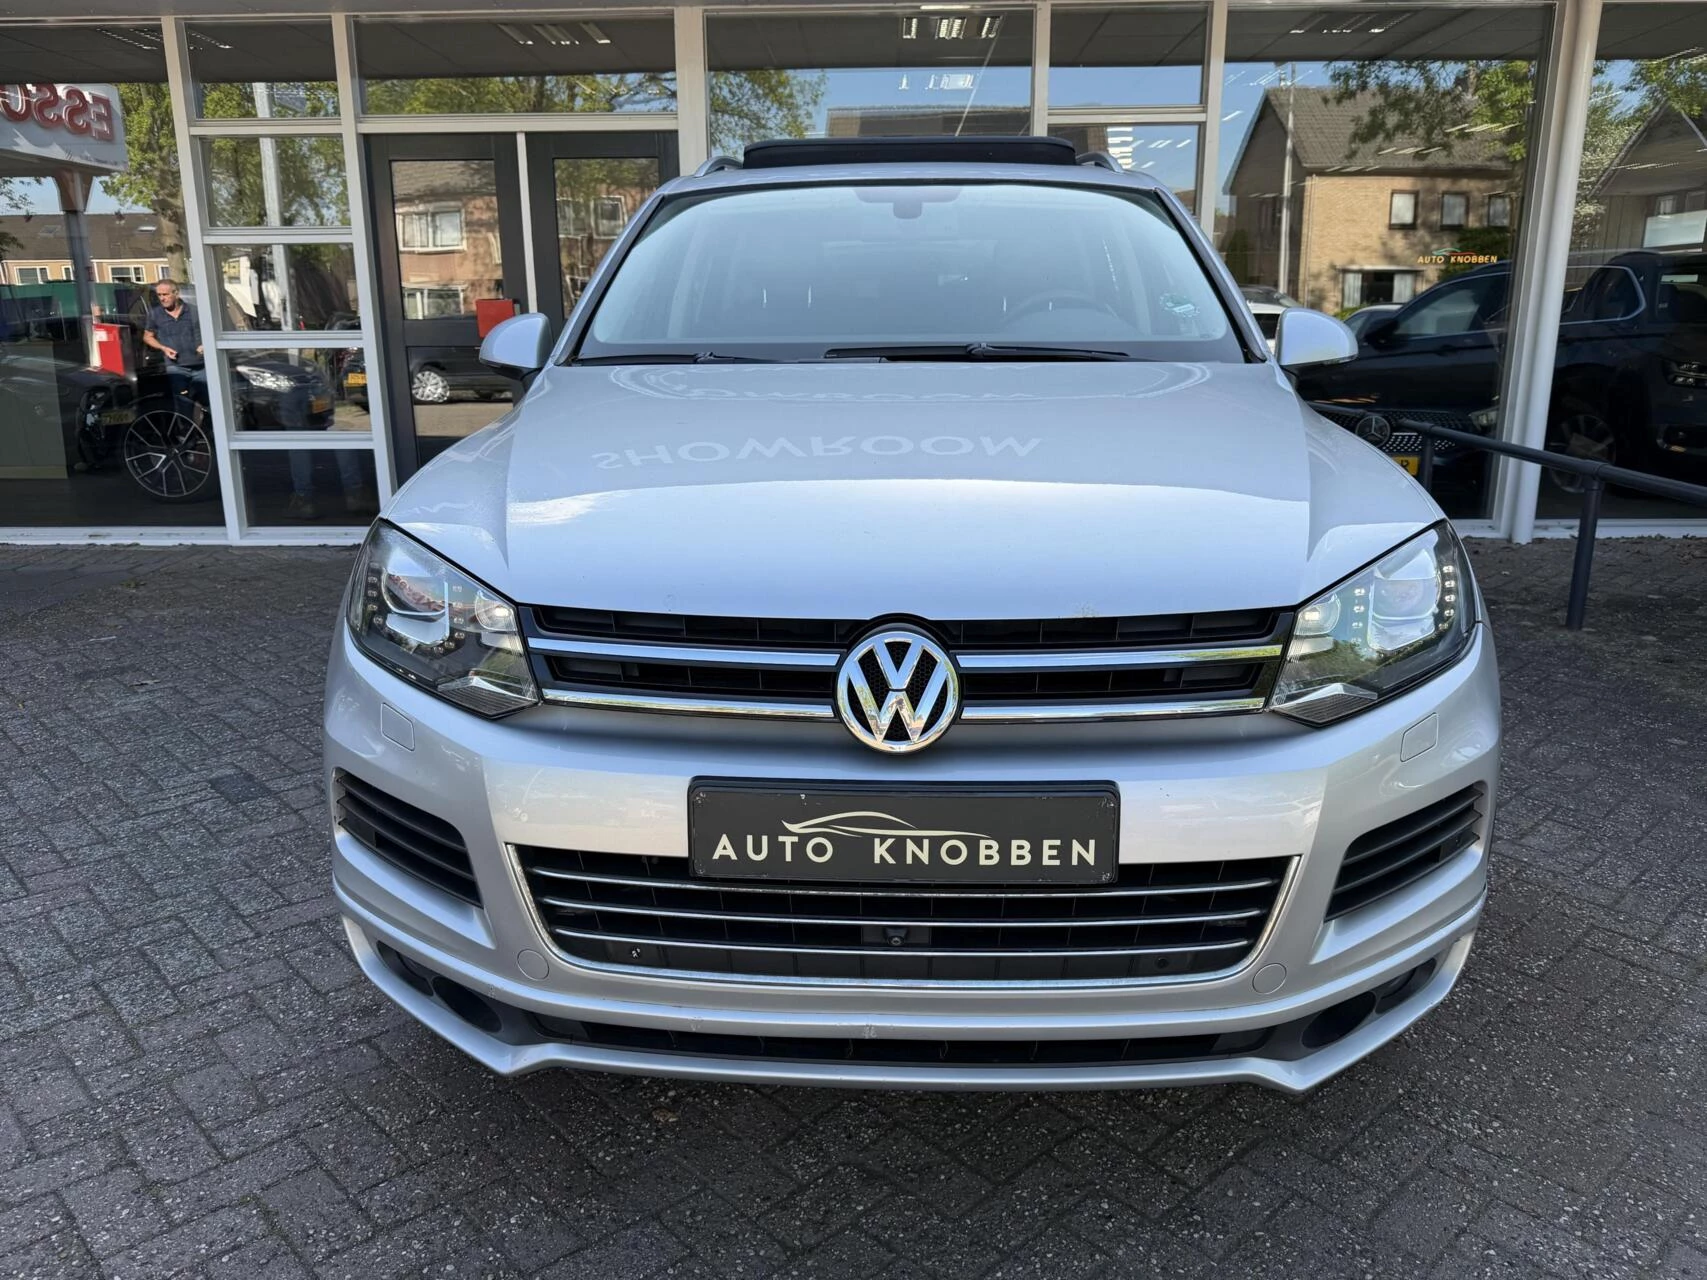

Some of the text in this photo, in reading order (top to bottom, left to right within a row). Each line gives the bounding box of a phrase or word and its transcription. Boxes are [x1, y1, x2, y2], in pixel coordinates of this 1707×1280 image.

[1417, 255, 1498, 264] AUTO KNOBBEN
[845, 634, 951, 746] VW
[712, 833, 1096, 866] AUTO KNOBBEN
